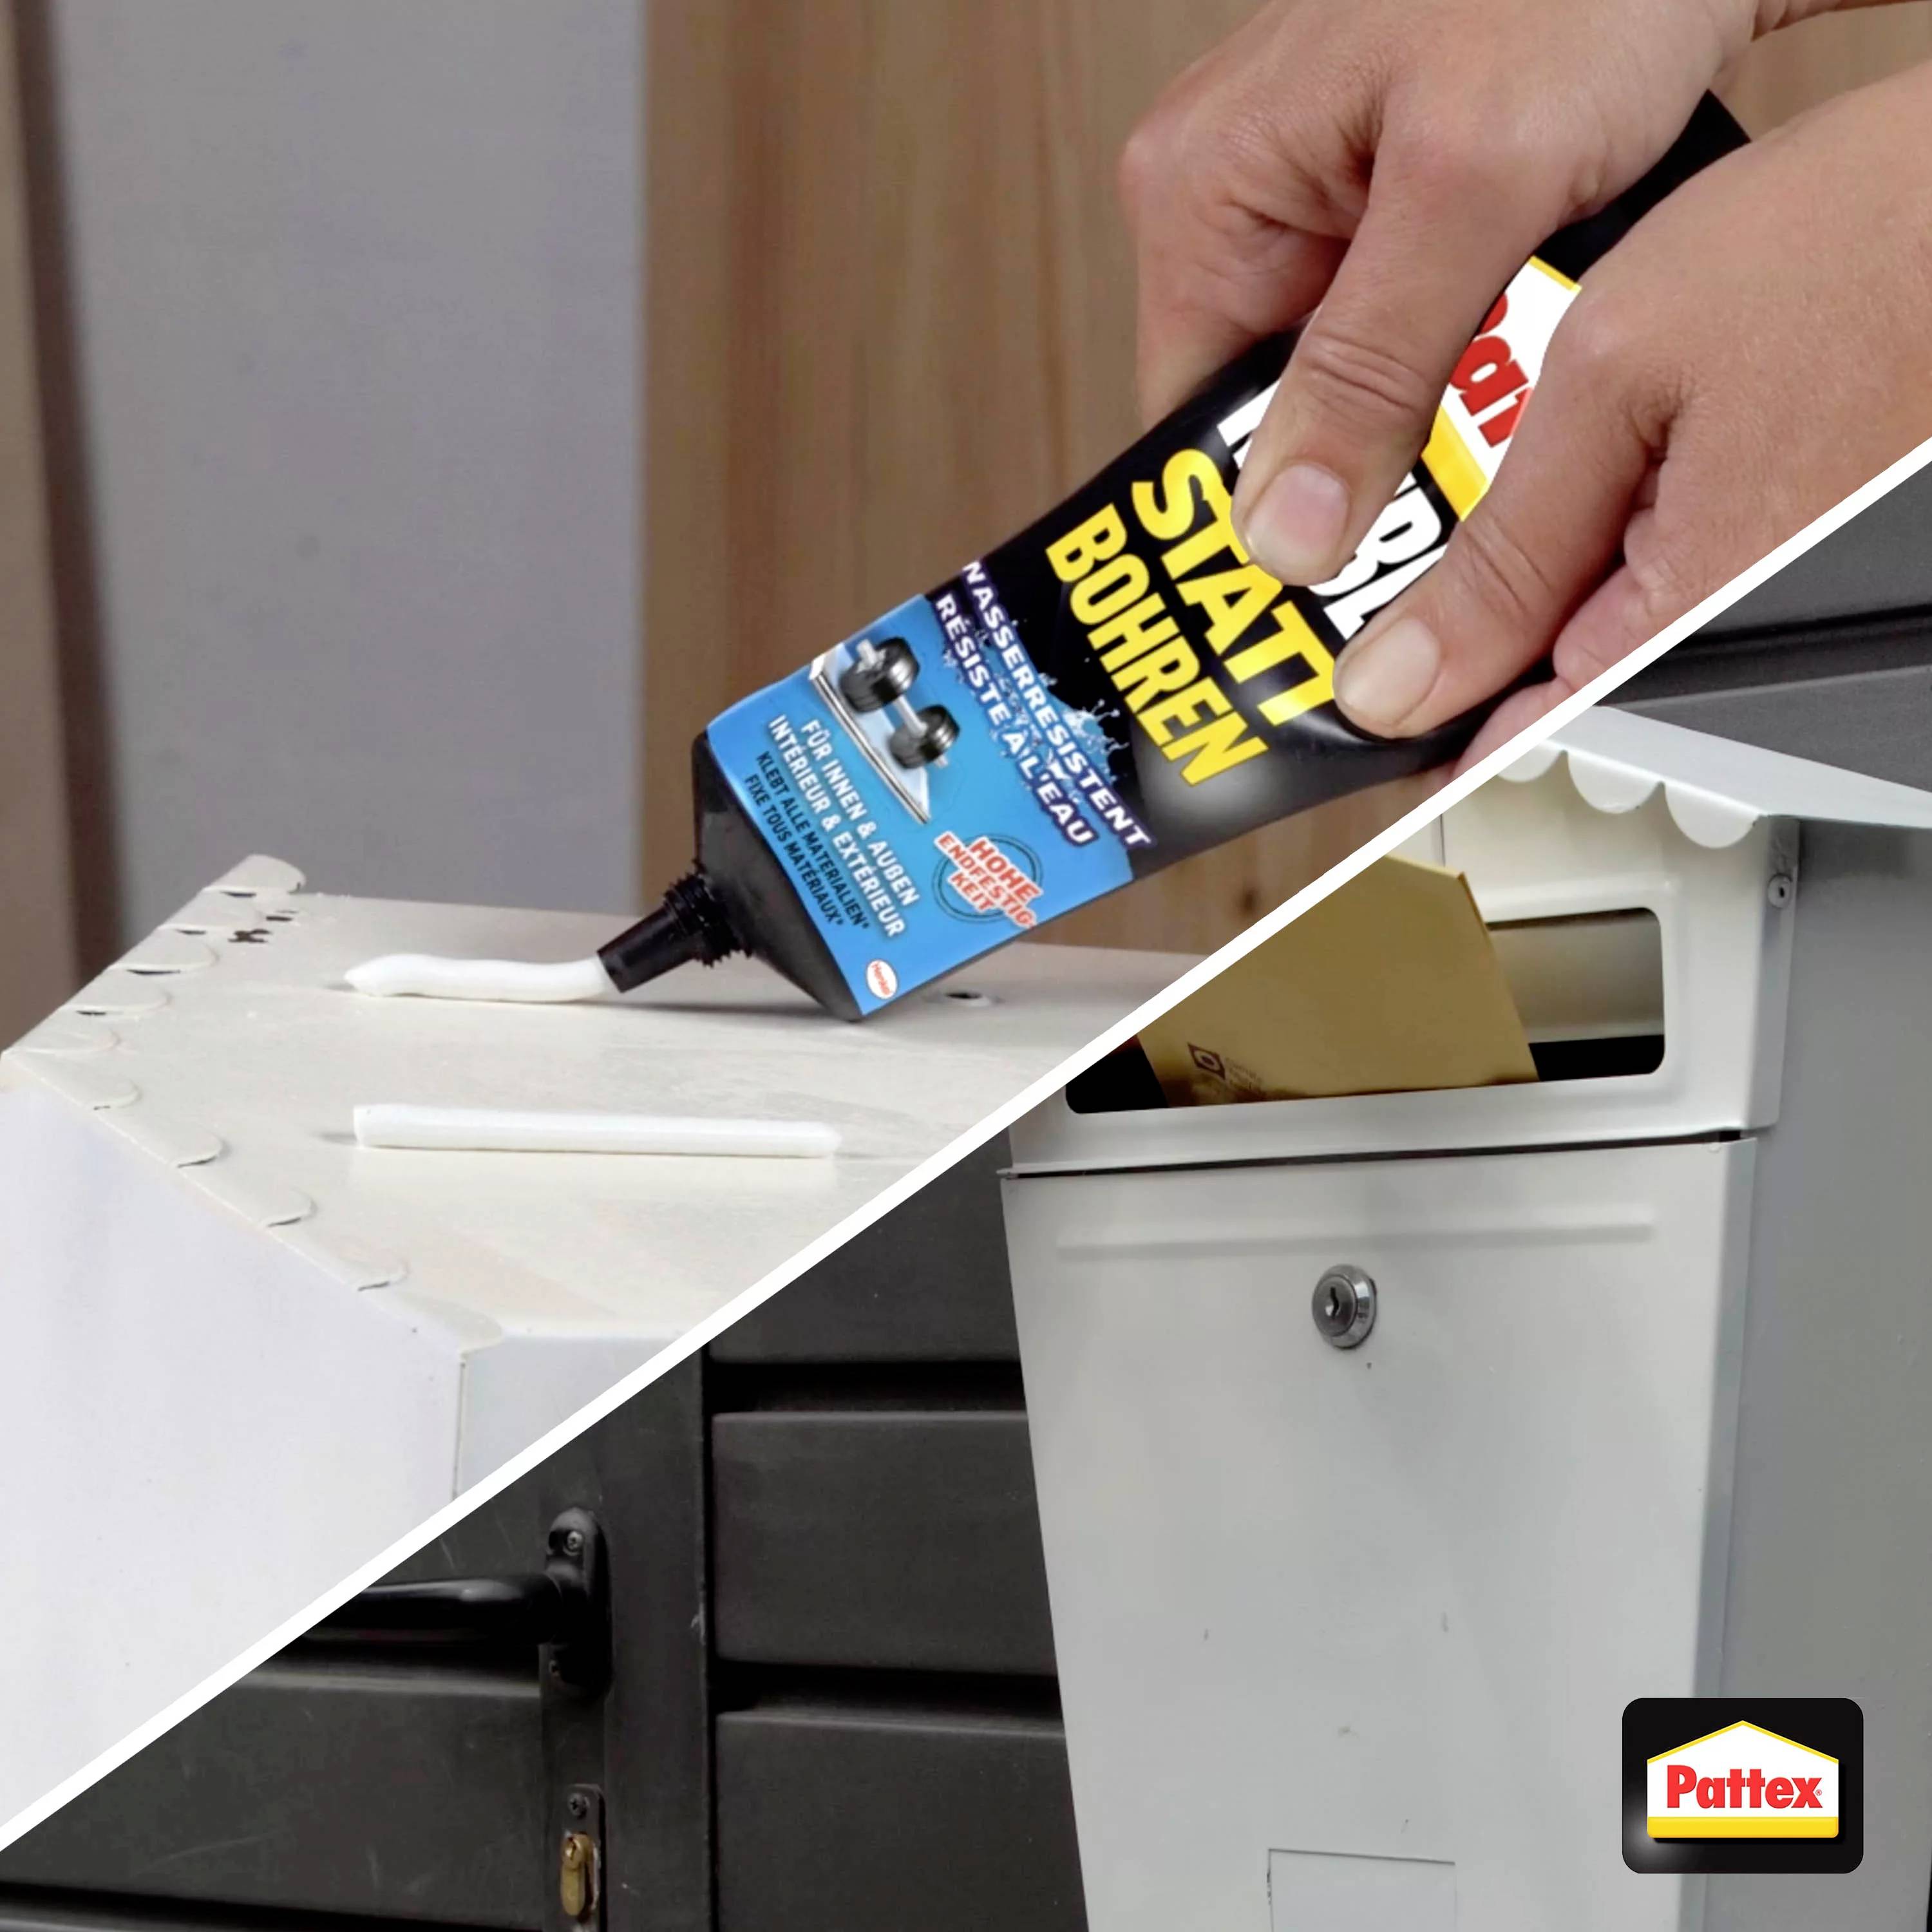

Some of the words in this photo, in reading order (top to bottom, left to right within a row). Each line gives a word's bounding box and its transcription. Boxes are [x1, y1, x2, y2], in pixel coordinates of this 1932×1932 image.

[1132, 448, 1335, 727] STATT
[1045, 502, 1270, 788] BOHREN
[744, 774, 772, 806] FIXE
[762, 804, 792, 842] TOUS
[756, 750, 790, 795] KLEBT
[781, 797, 811, 833] ALLE
[800, 719, 833, 761] FÜR
[822, 759, 867, 820] INNEN
[857, 821, 876, 839] &
[1019, 755, 1094, 843] L'EAU
[768, 714, 831, 814] INTÉRIEUR
[821, 814, 841, 831] &
[833, 831, 905, 937] EXTÉRIEUR
[951, 873, 994, 910] KEIT
[969, 839, 1041, 903] HOHE
